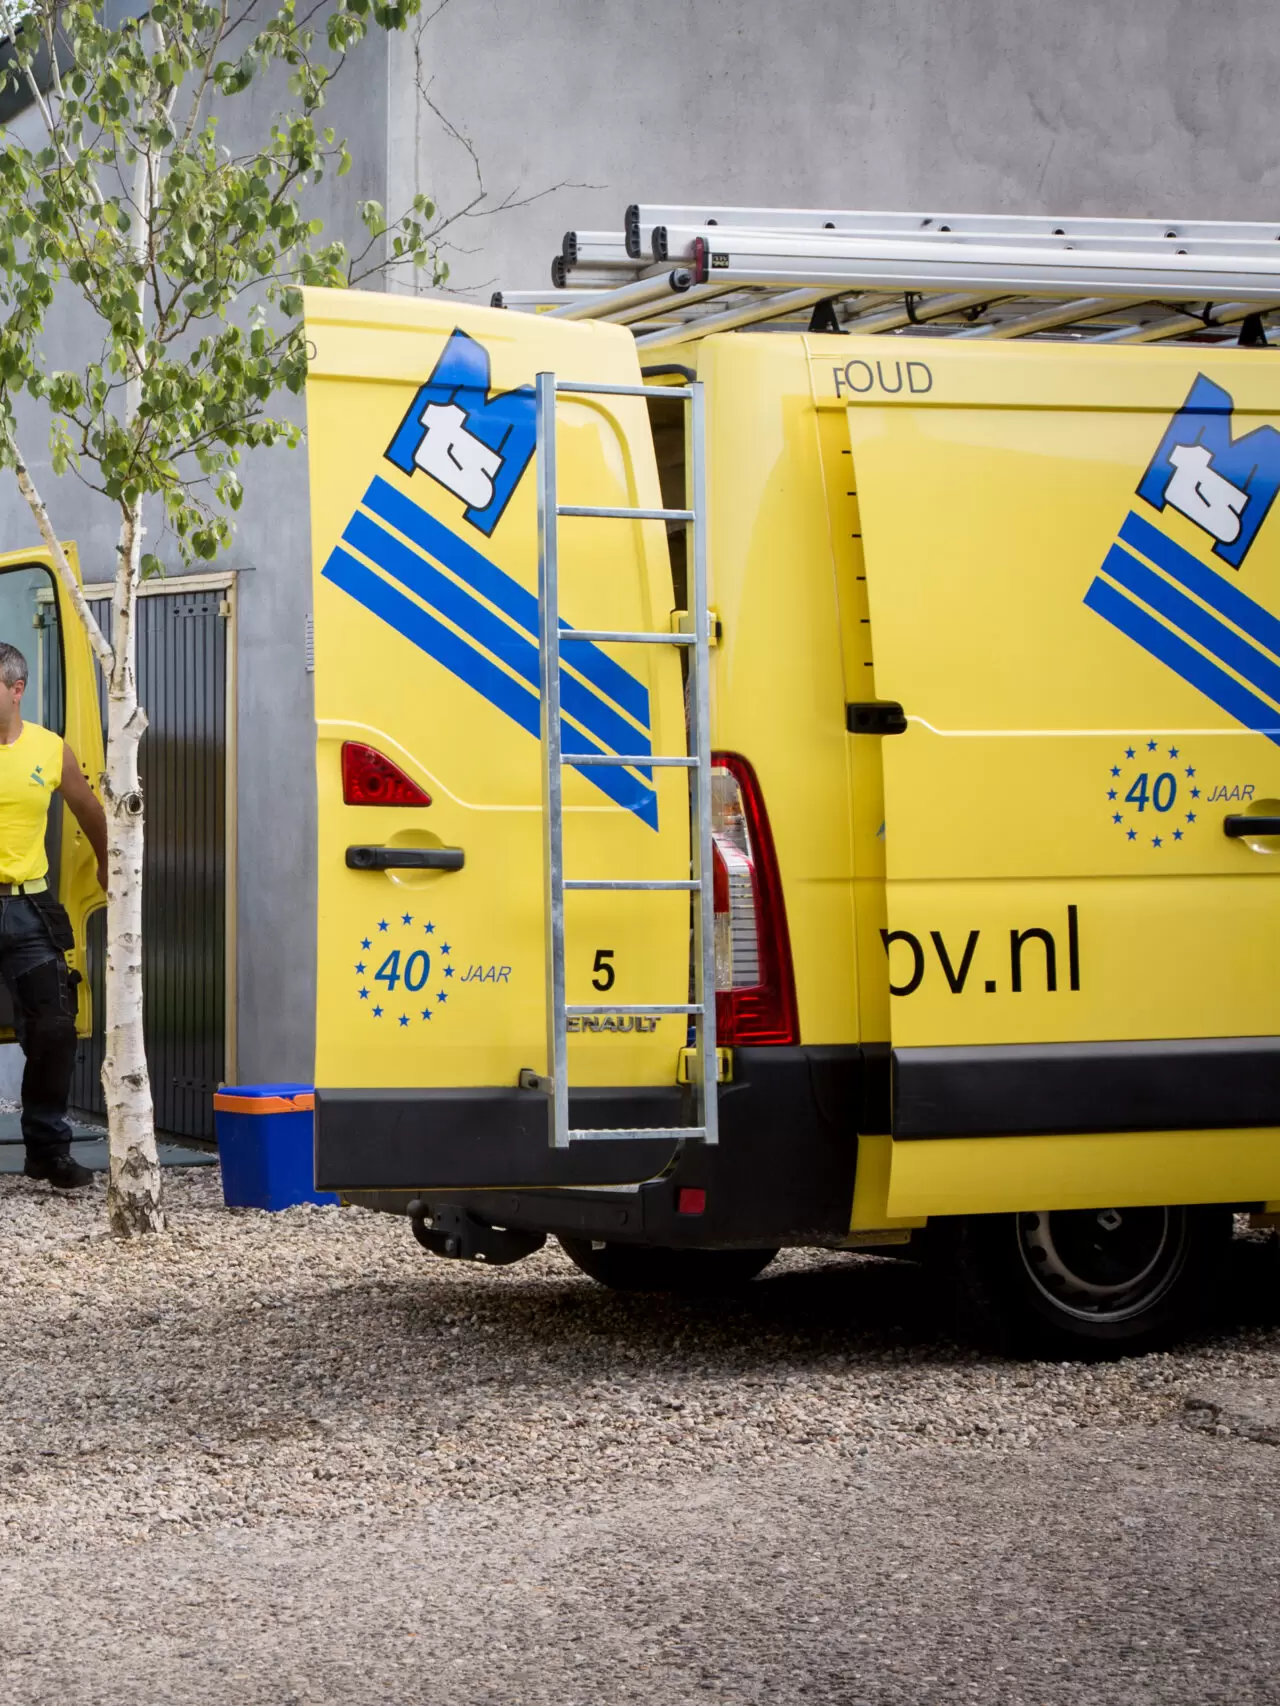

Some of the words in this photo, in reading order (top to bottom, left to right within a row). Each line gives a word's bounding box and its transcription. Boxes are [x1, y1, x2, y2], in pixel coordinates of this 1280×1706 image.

[1124, 772, 1177, 813] 40
[1207, 784, 1256, 803] JAAR
[374, 949, 430, 992] 40
[460, 965, 512, 984] JAAR
[591, 949, 616, 992] 5
[565, 1015, 662, 1033] ENAULT
